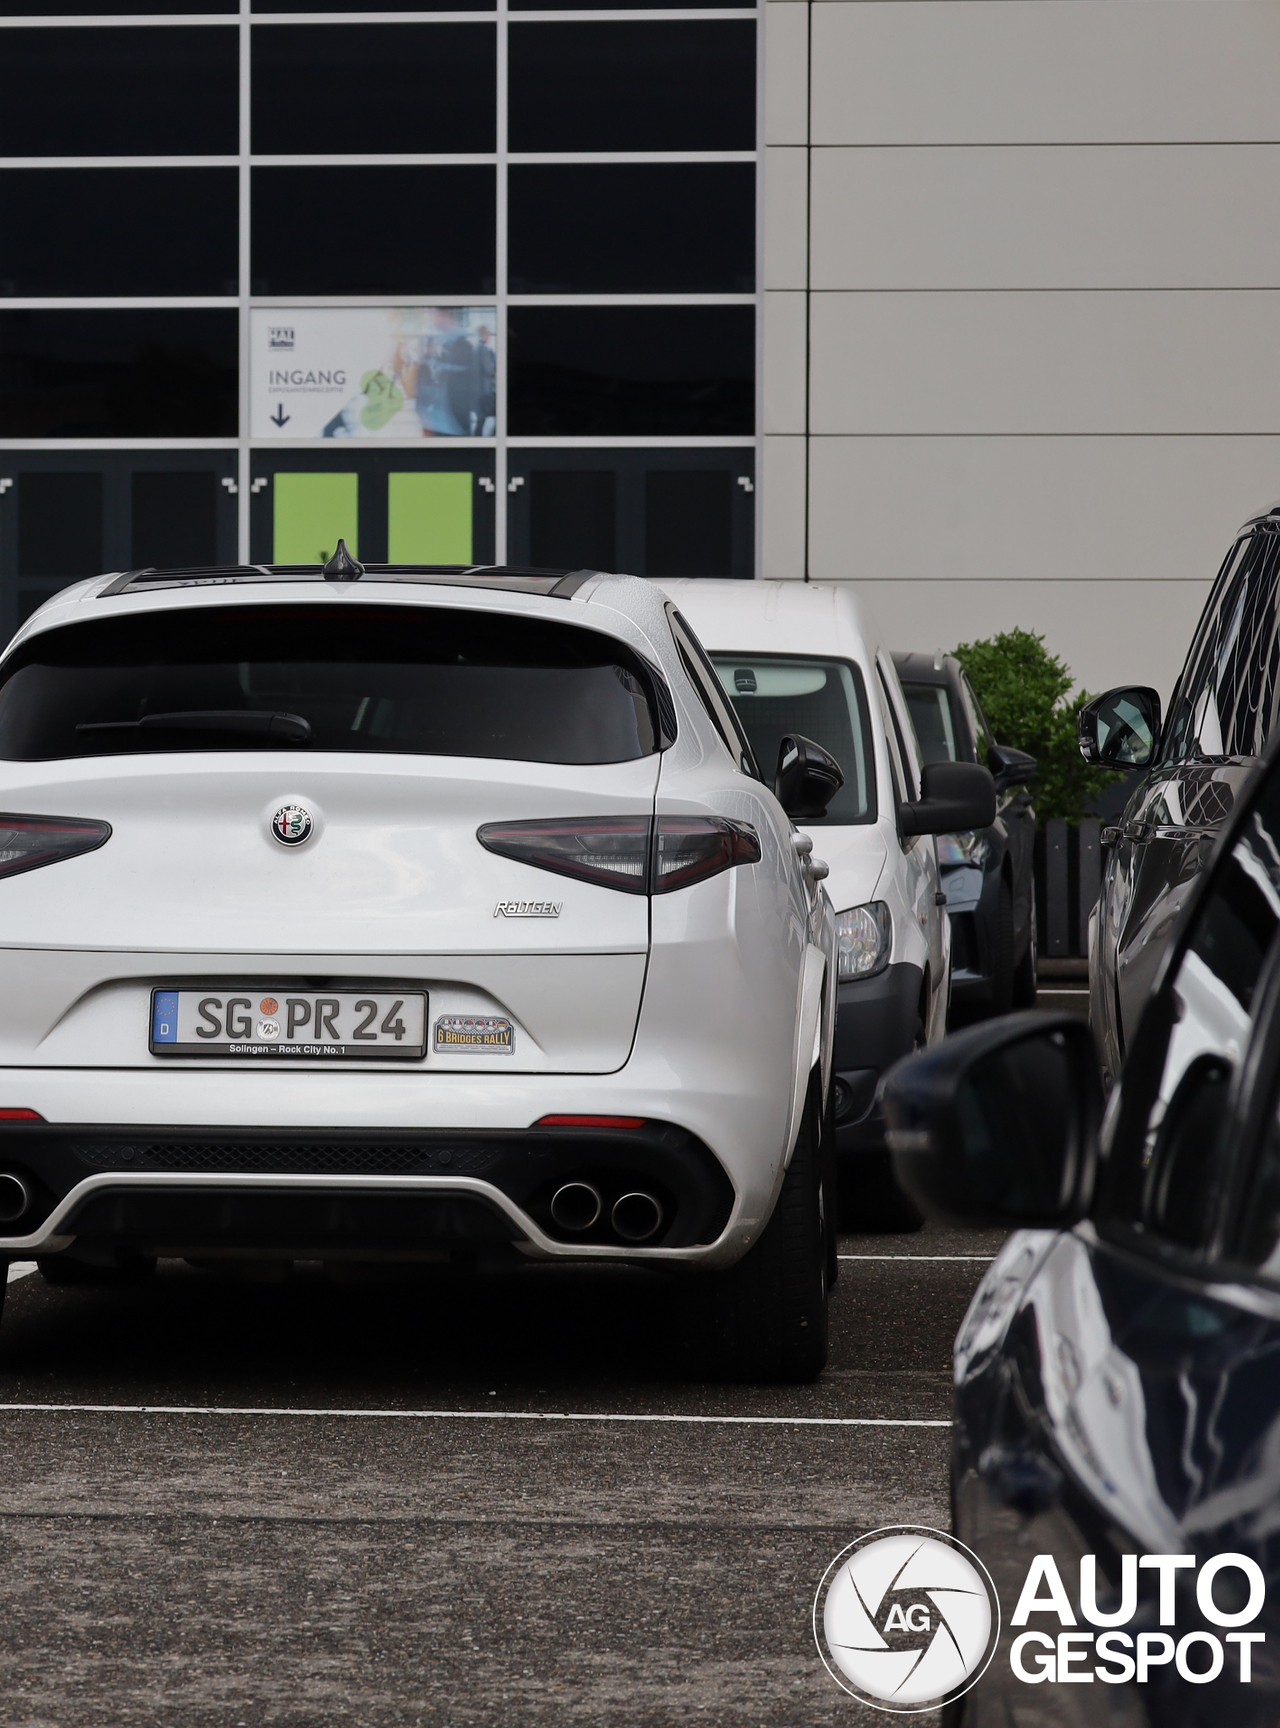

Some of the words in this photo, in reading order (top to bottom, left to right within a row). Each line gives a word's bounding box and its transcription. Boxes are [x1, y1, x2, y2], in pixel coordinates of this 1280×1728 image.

[269, 370, 346, 385] INGANG
[273, 807, 287, 824] ALFA
[289, 806, 311, 825] ROMEO
[196, 998, 252, 1039] SG
[286, 998, 340, 1039] PR
[353, 999, 406, 1040] 24
[160, 1023, 170, 1035] D
[437, 1029, 444, 1043] 6
[445, 1031, 482, 1044] BRIDGES
[484, 1031, 510, 1045] RALLY
[229, 1044, 269, 1054] Solingen
[278, 1045, 301, 1053] Rock
[303, 1045, 321, 1055] City
[323, 1046, 339, 1054] No.
[341, 1046, 345, 1054] 1
